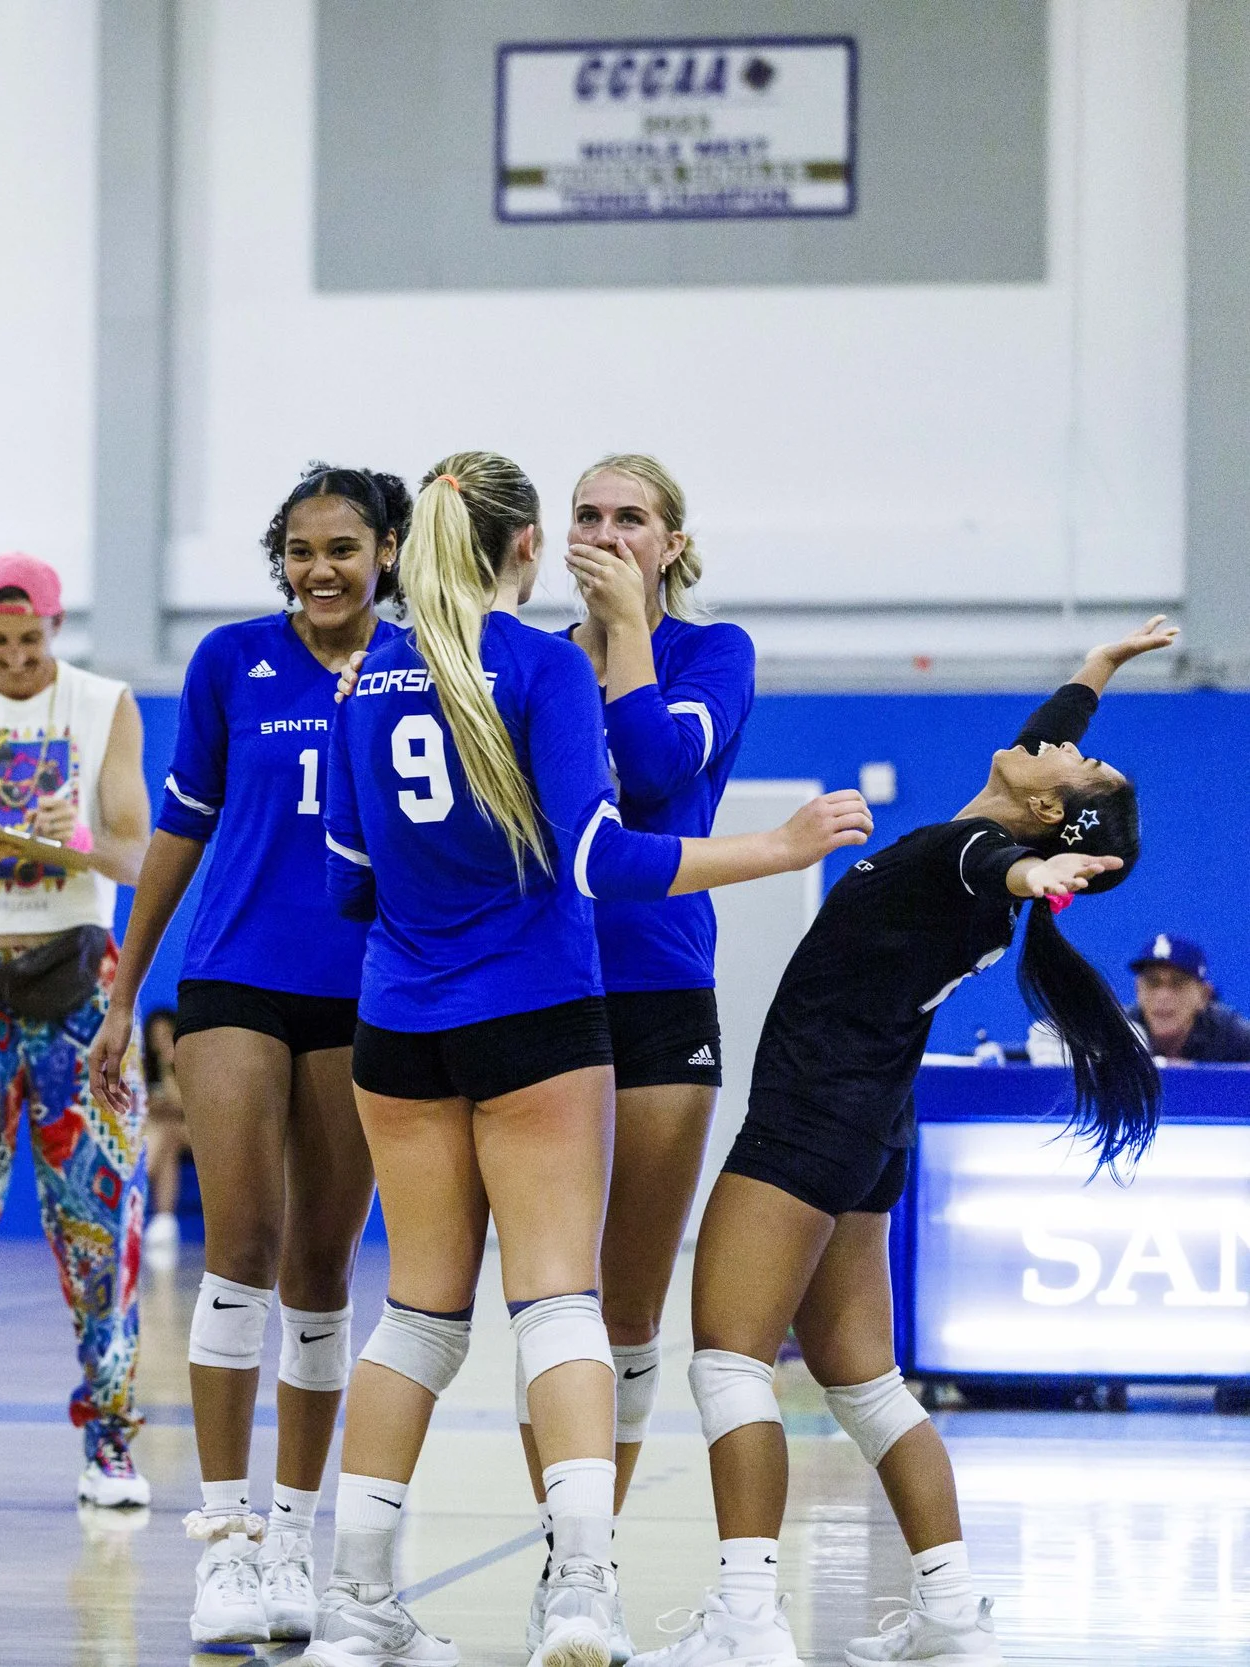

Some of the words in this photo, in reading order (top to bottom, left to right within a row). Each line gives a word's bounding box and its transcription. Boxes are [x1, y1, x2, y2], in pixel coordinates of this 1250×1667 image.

[356, 668, 498, 697] CORSS
[260, 719, 328, 735] SANTA
[297, 748, 321, 815] 1
[391, 713, 454, 824] 9
